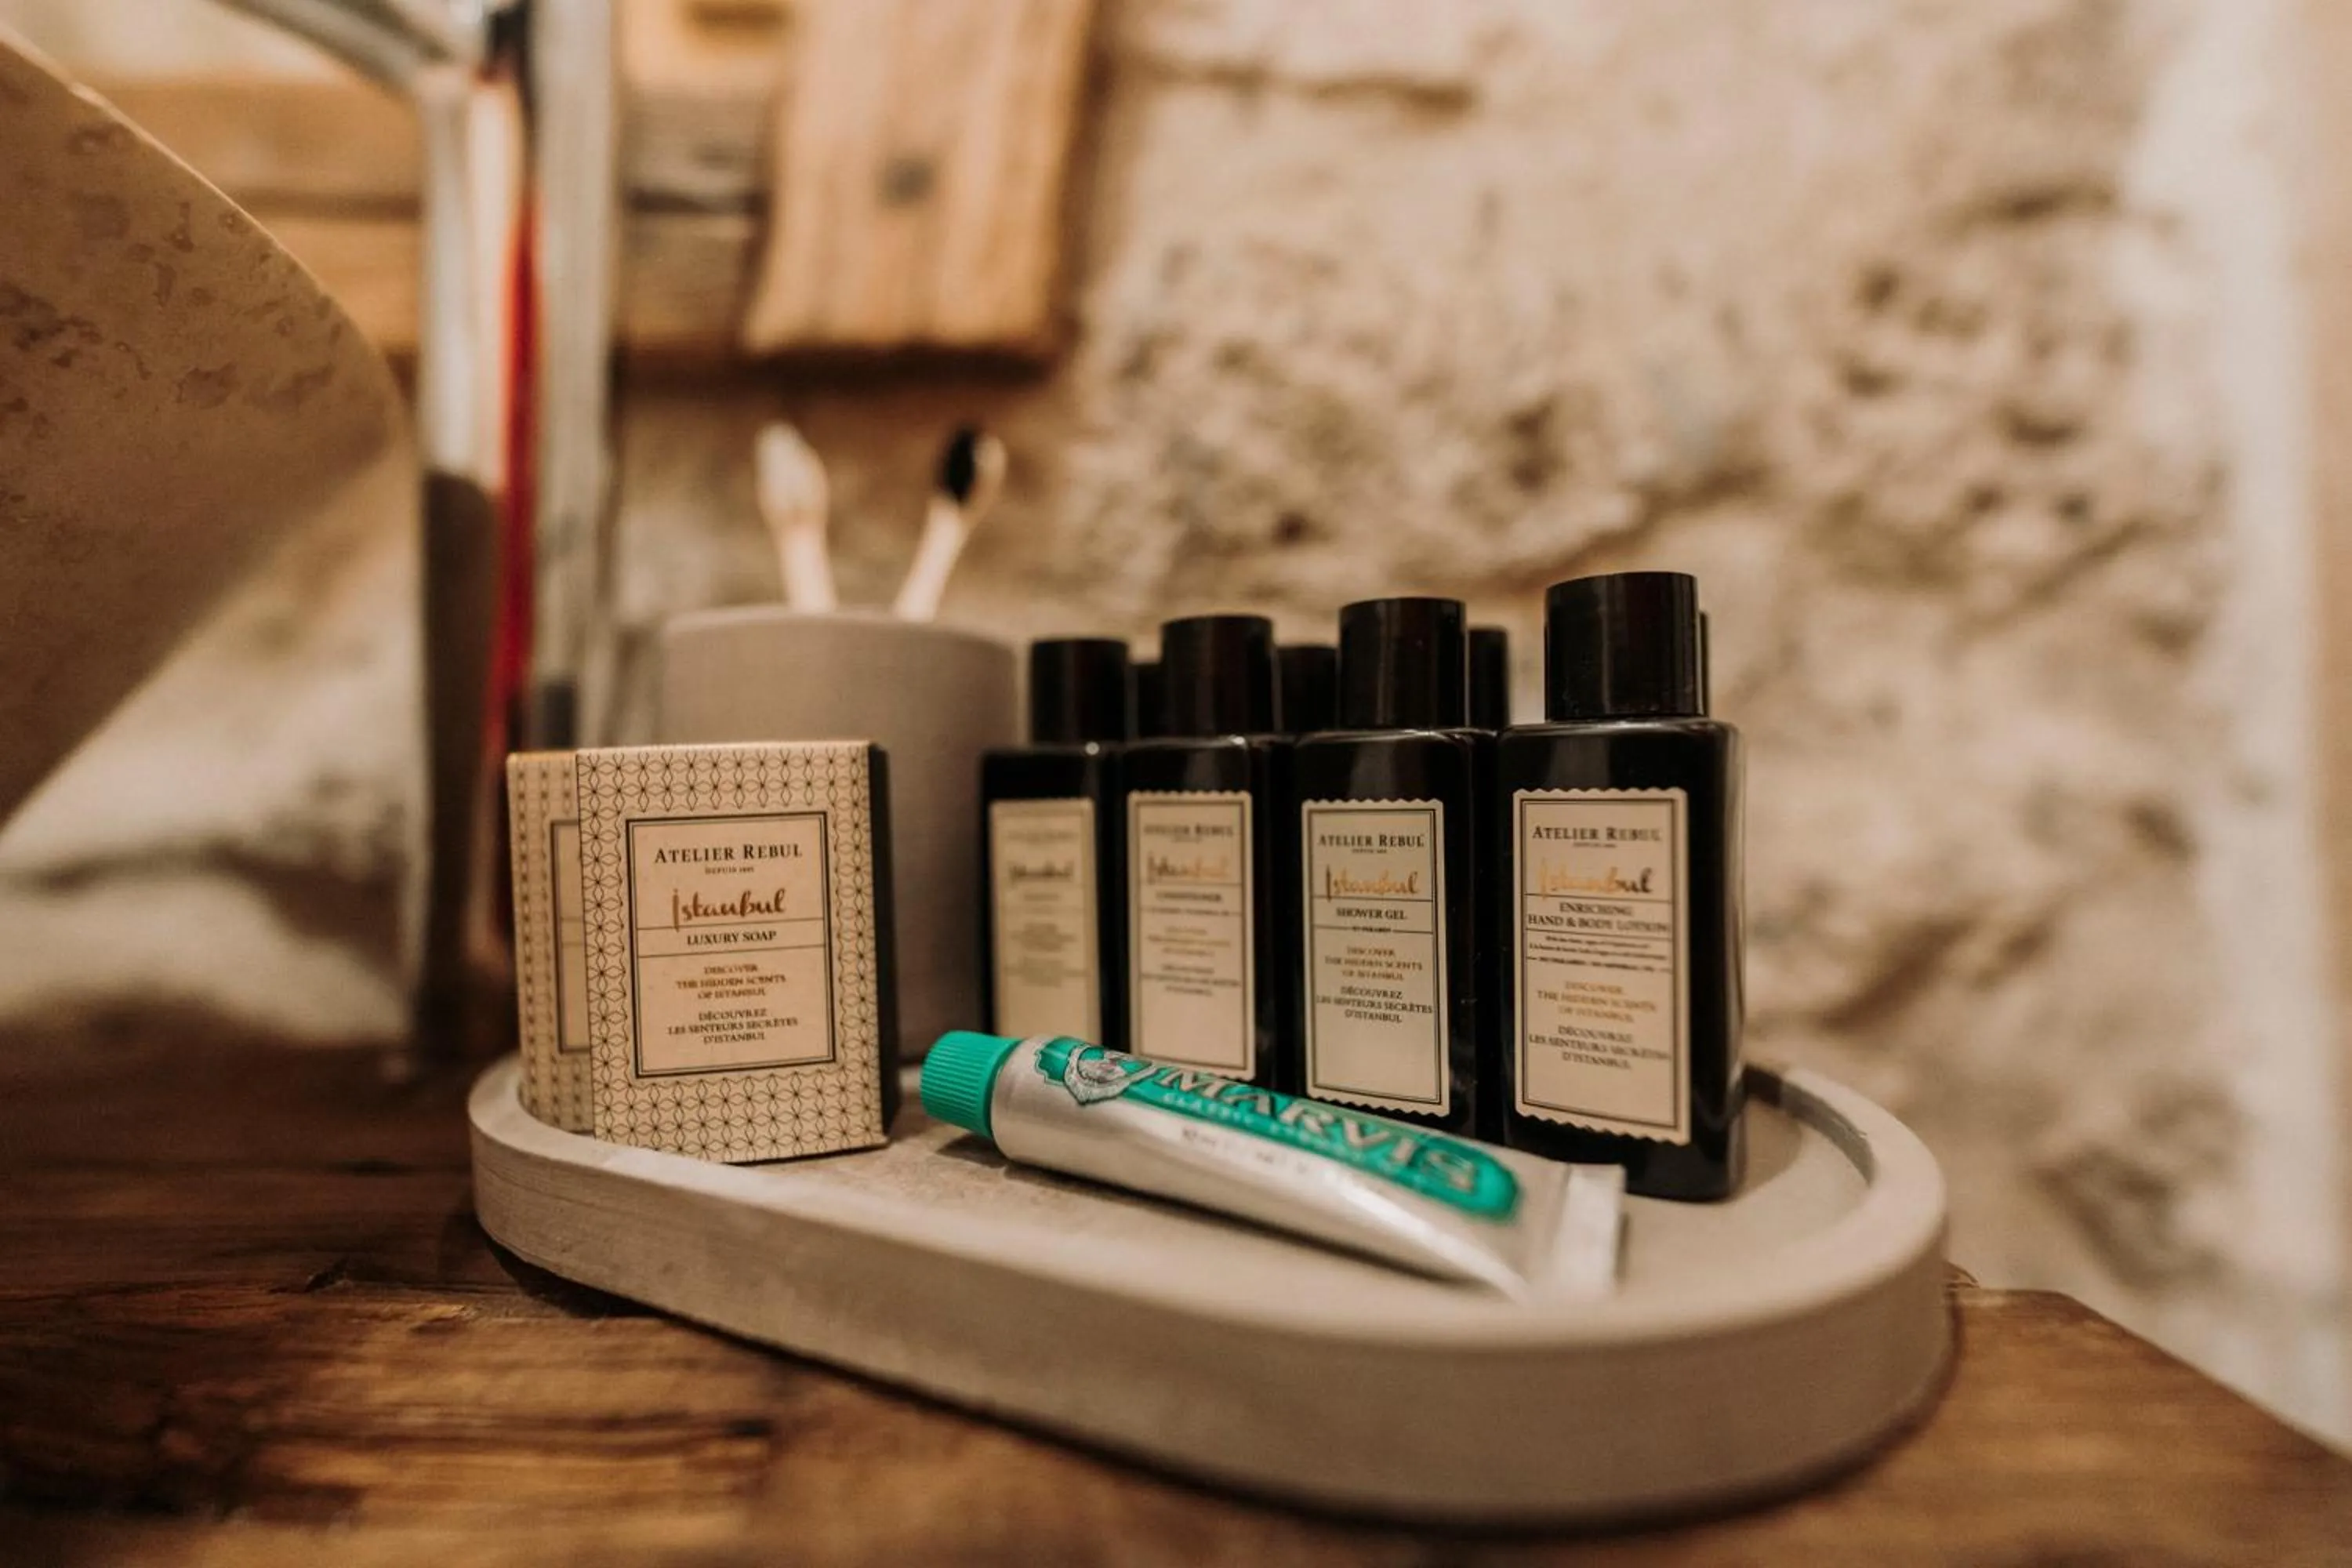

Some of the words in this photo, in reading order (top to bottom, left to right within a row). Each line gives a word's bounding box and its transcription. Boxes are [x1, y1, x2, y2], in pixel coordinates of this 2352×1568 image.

[1532, 826, 1599, 840] ATELIER
[1319, 833, 1373, 848] ATELIER
[1378, 833, 1425, 848] REBUL
[655, 846, 735, 864] ATELIER
[743, 843, 803, 860] REBUL
[1336, 907, 1383, 920] SHOWER
[1385, 909, 1408, 920] GEL
[1559, 902, 1634, 916] ENRICHING
[1528, 913, 1563, 927] HAND
[1566, 916, 1577, 927] &
[1578, 916, 1613, 930] BODY
[687, 933, 739, 946] LUXURY
[742, 931, 777, 942] SOAP
[703, 964, 758, 975] DISCOVER
[675, 980, 699, 989] THE
[714, 987, 767, 999] ISTANBUL
[667, 1025, 686, 1036] LES
[688, 1021, 744, 1034] SENTEURS
[1157, 1065, 1480, 1195] MARVIS
